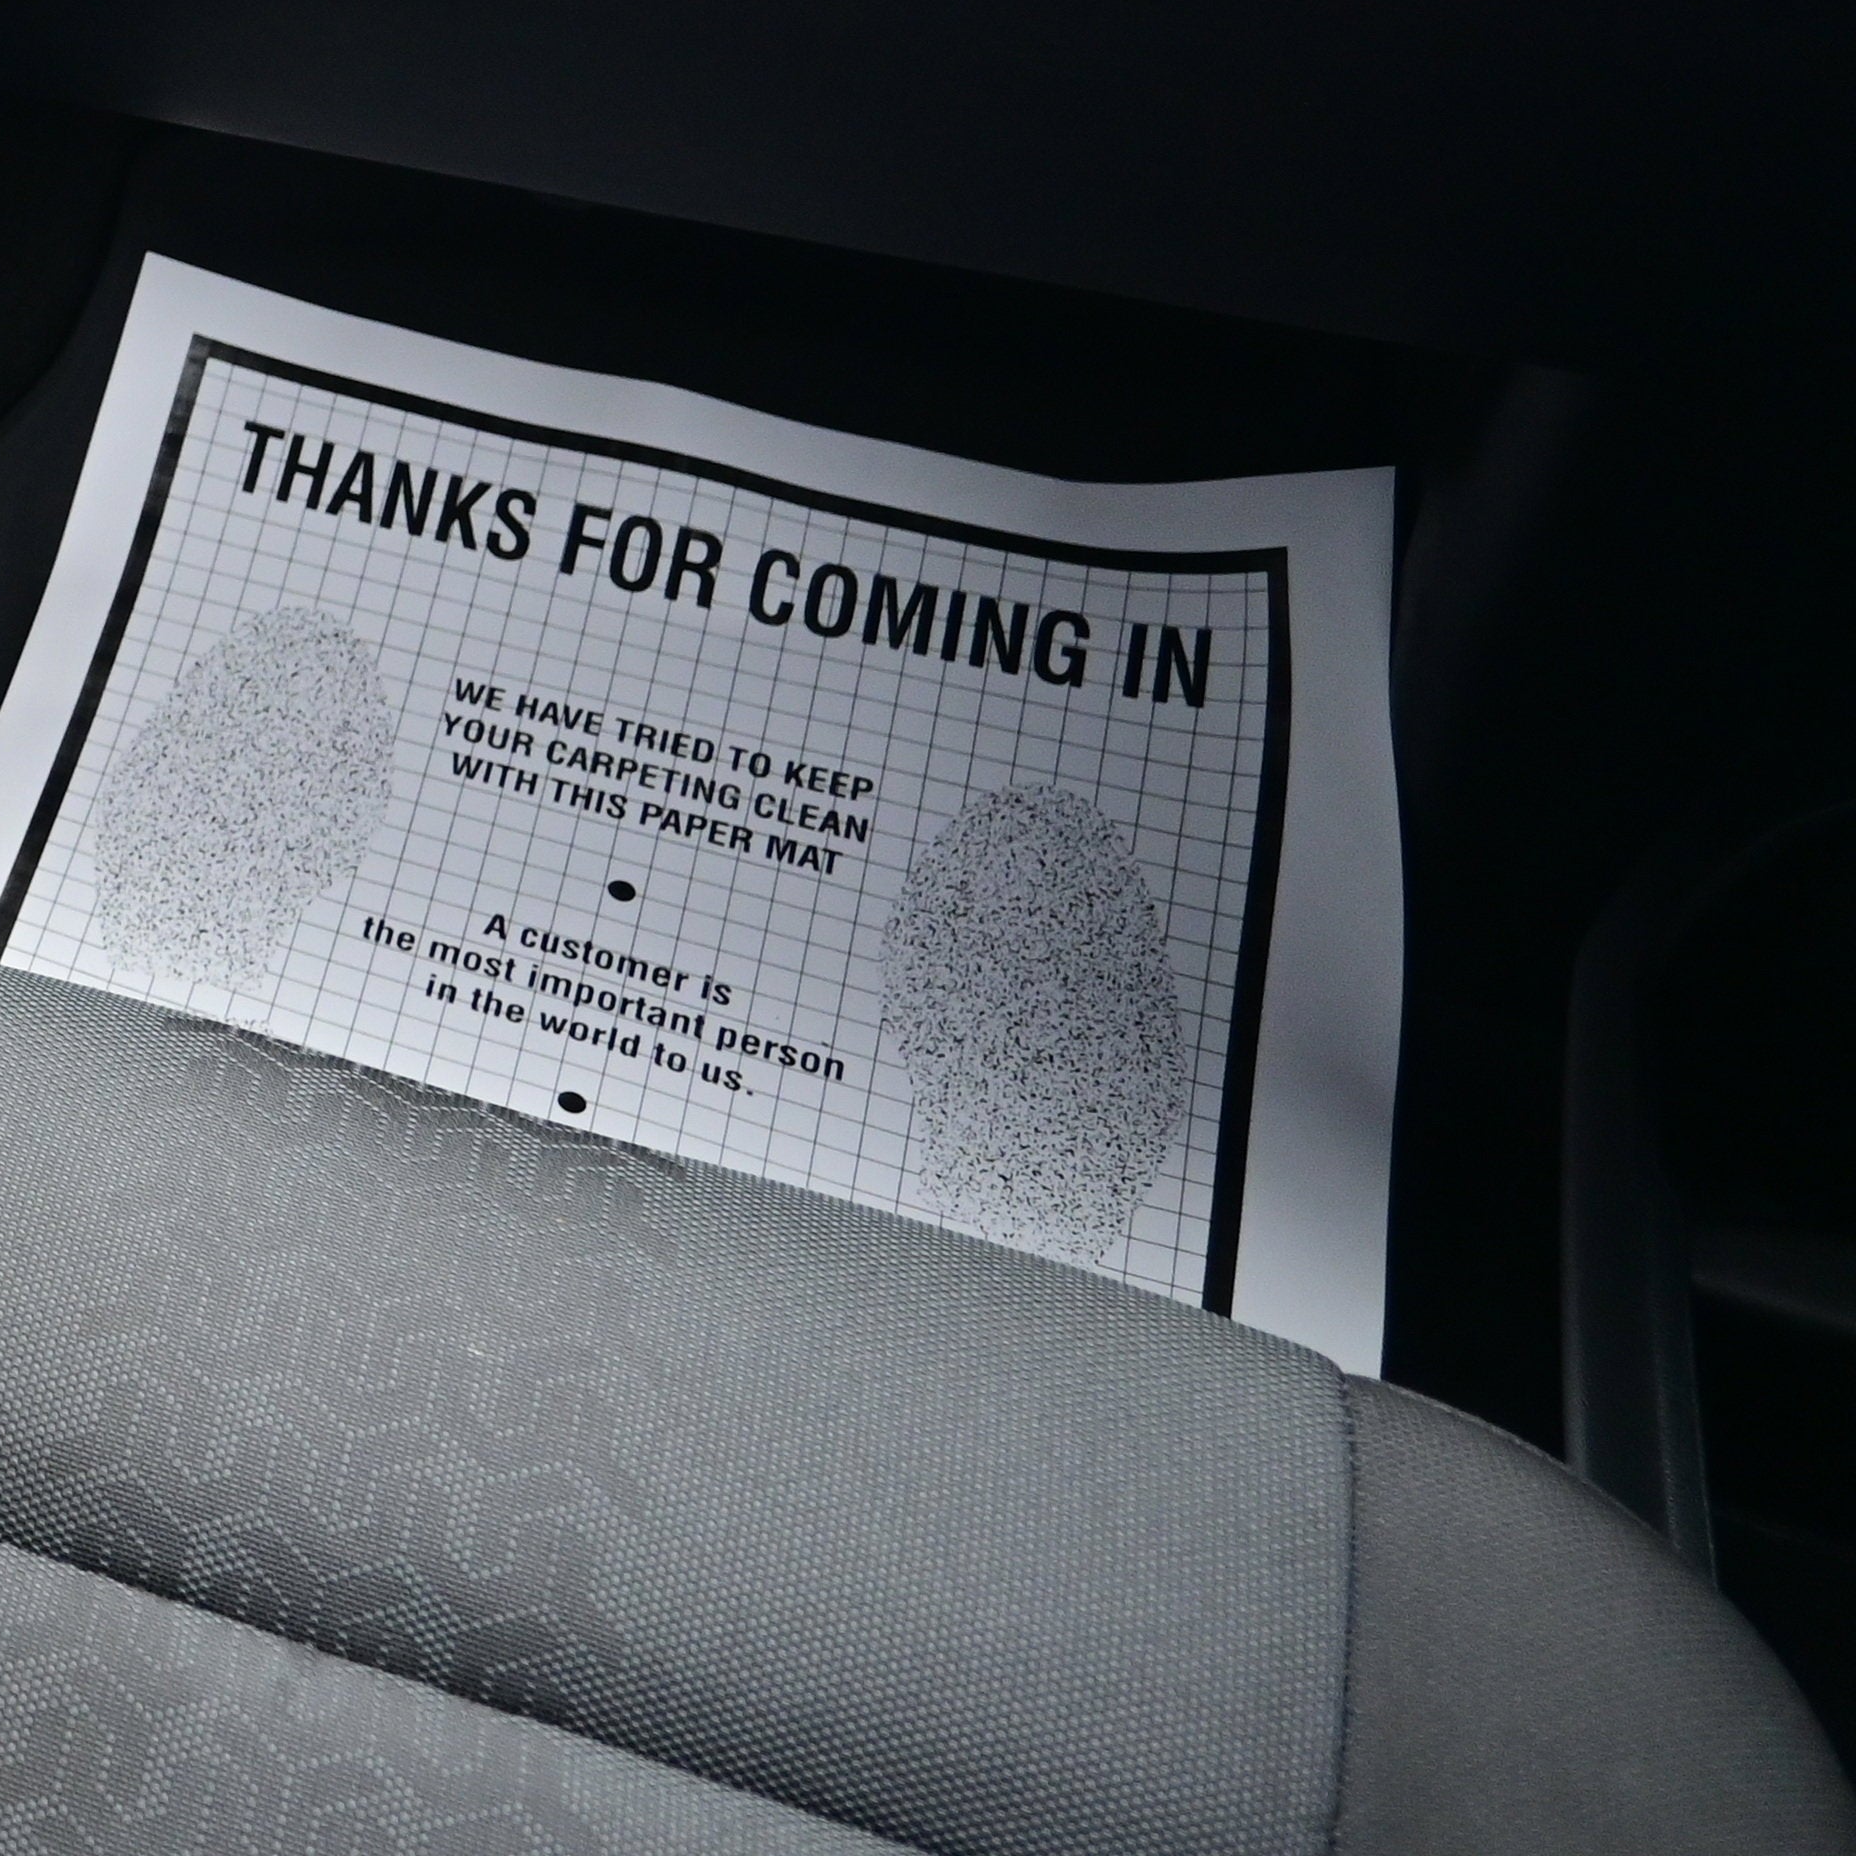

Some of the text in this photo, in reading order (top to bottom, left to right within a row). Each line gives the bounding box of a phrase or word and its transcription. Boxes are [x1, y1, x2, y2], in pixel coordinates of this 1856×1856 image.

[242, 421, 1212, 709] THANKS FOR COMING IN
[442, 712, 869, 843] YOUR CARPETING CLEAN
[454, 678, 874, 802] WE HAVE TRIED TO KEEP
[451, 752, 844, 875] WITH THIS PAPER MAT
[361, 915, 845, 1081] the most important person
[482, 913, 734, 1007] A customer is
[424, 973, 755, 1096] in the world to us.
